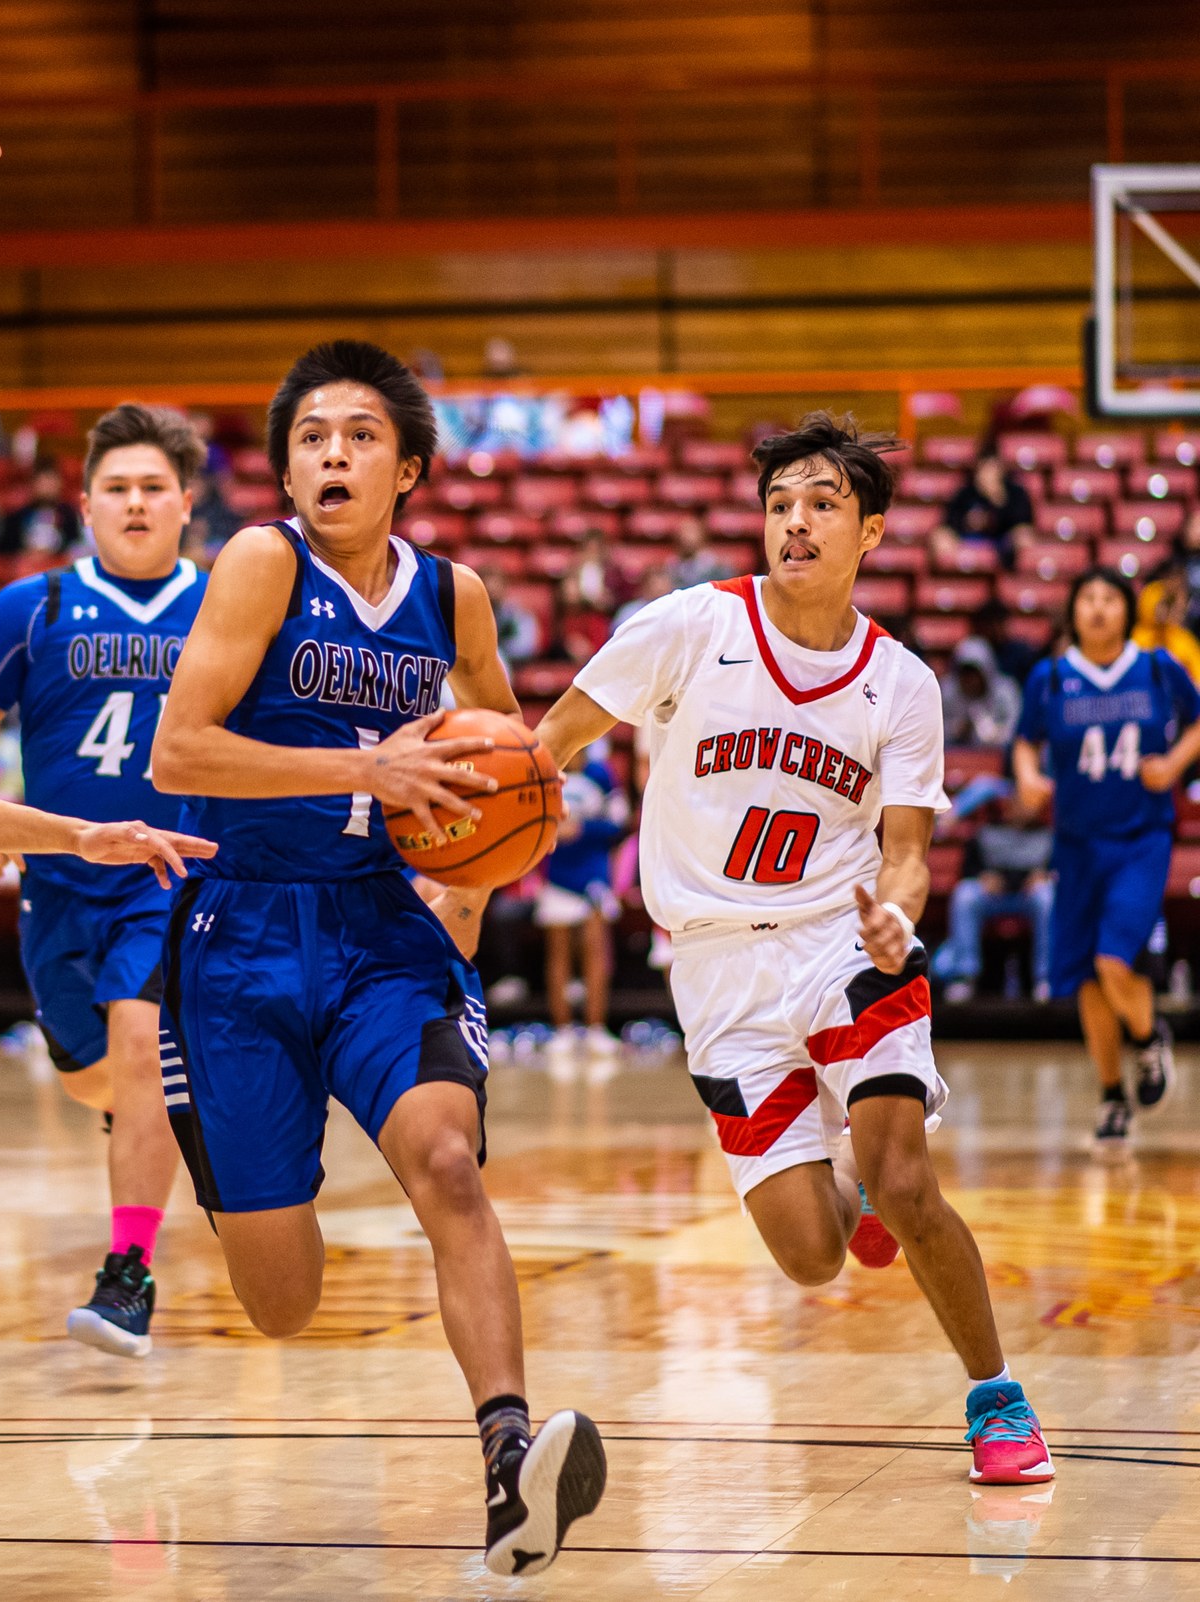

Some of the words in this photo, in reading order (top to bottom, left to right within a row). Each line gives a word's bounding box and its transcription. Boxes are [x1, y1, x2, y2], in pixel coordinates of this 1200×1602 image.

[68, 632, 189, 681] OELRIC
[694, 728, 782, 778] CROW
[780, 732, 873, 806] CREEK
[1077, 721, 1141, 783] 44
[723, 805, 820, 884] 10
